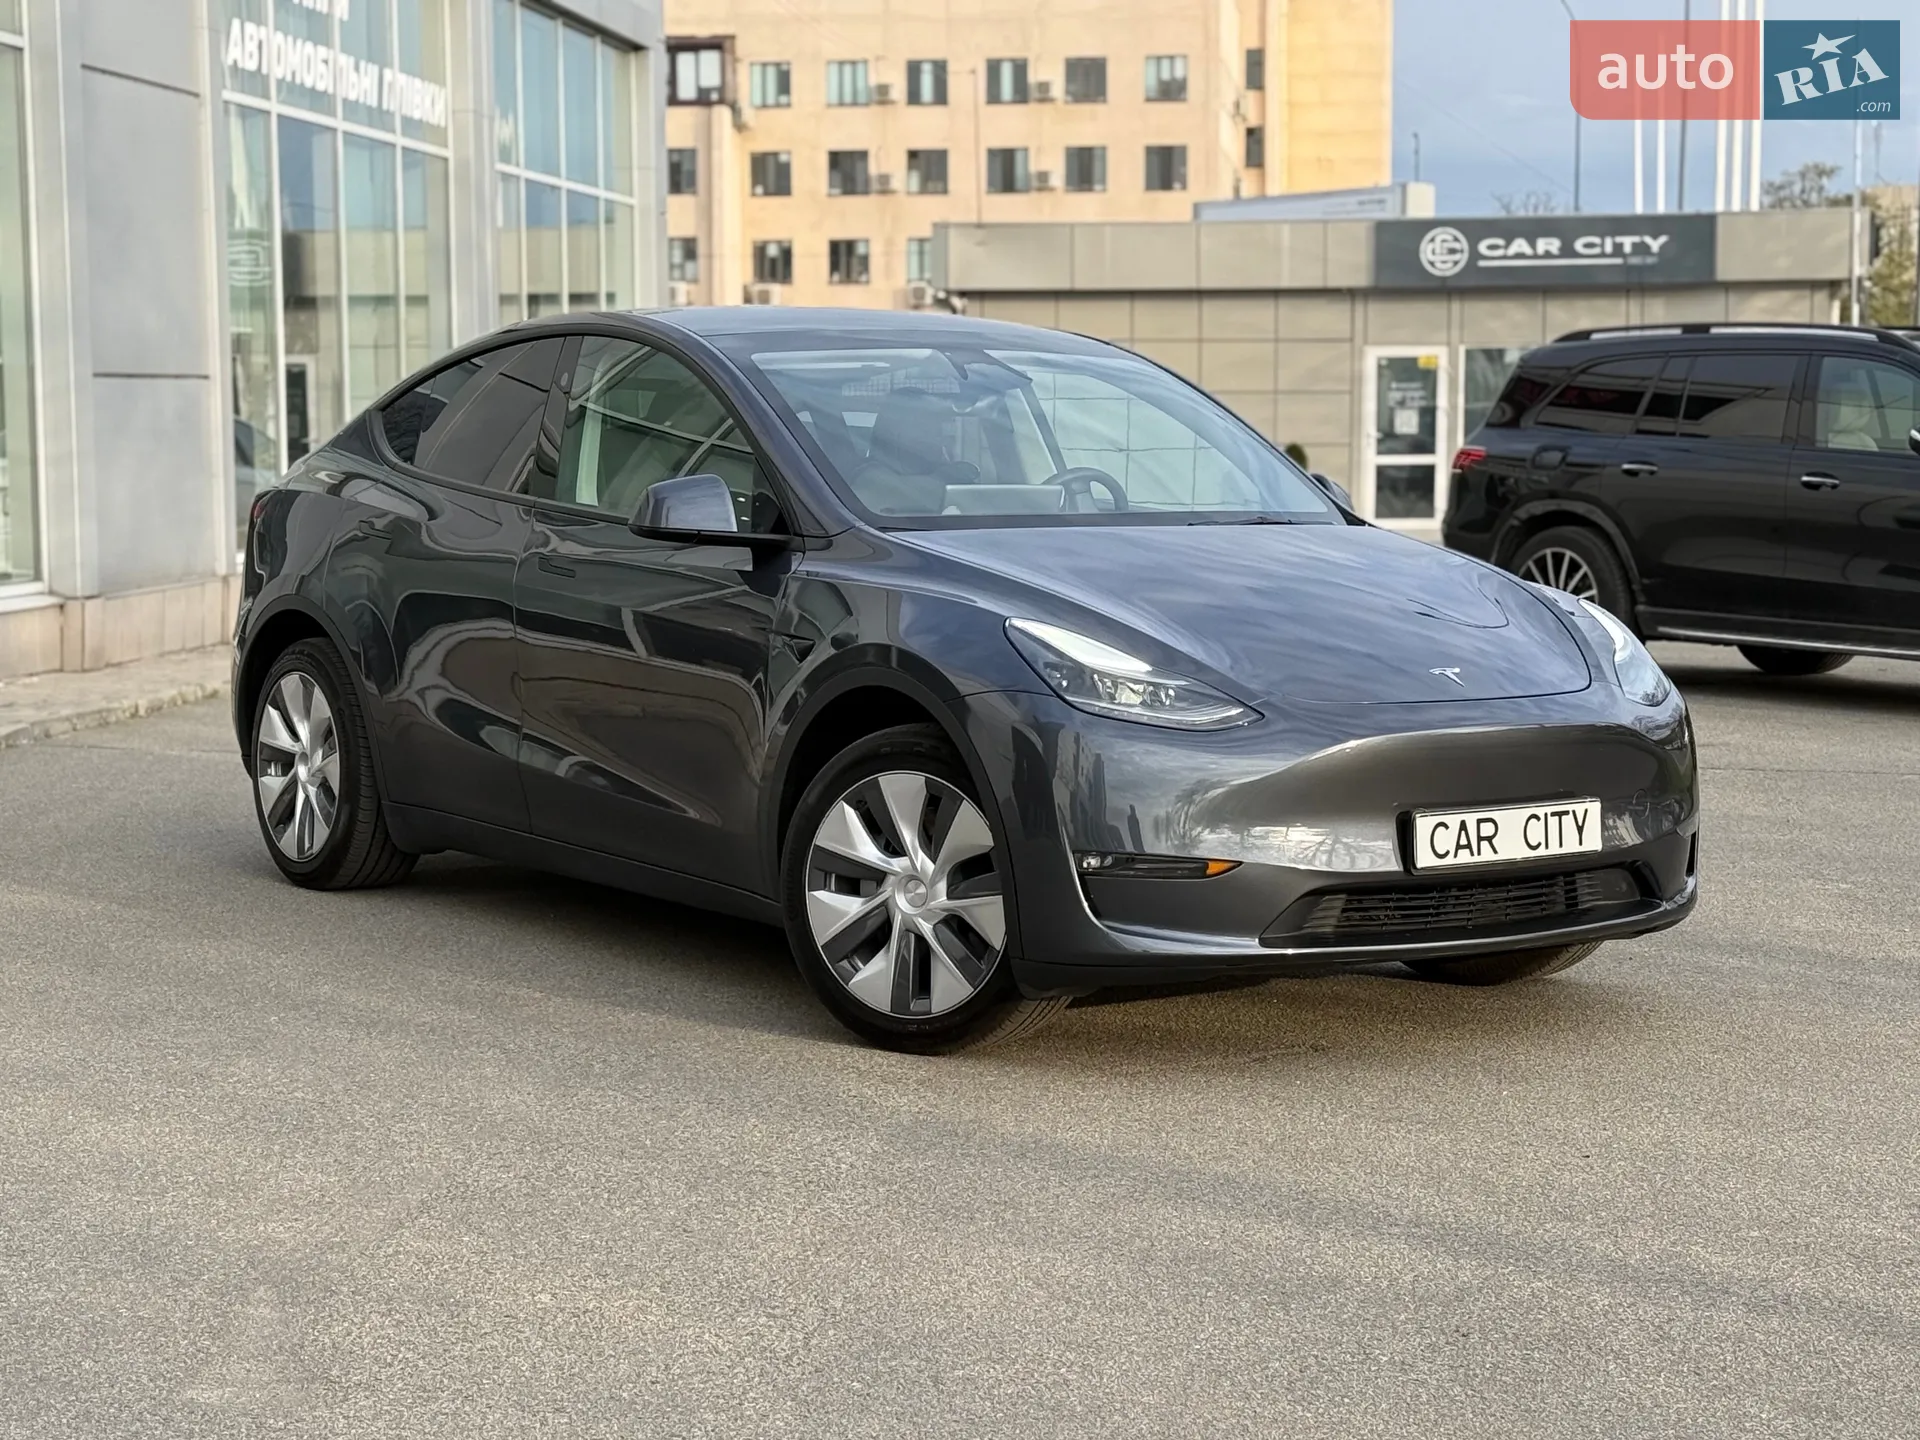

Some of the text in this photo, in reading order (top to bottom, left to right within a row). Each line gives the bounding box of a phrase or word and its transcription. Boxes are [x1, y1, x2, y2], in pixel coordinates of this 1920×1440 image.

[226, 17, 379, 108] АВТОМОБІЛЬНІ
[1477, 234, 1670, 257] CAR CITY
[1429, 808, 1589, 860] CAR CITY
